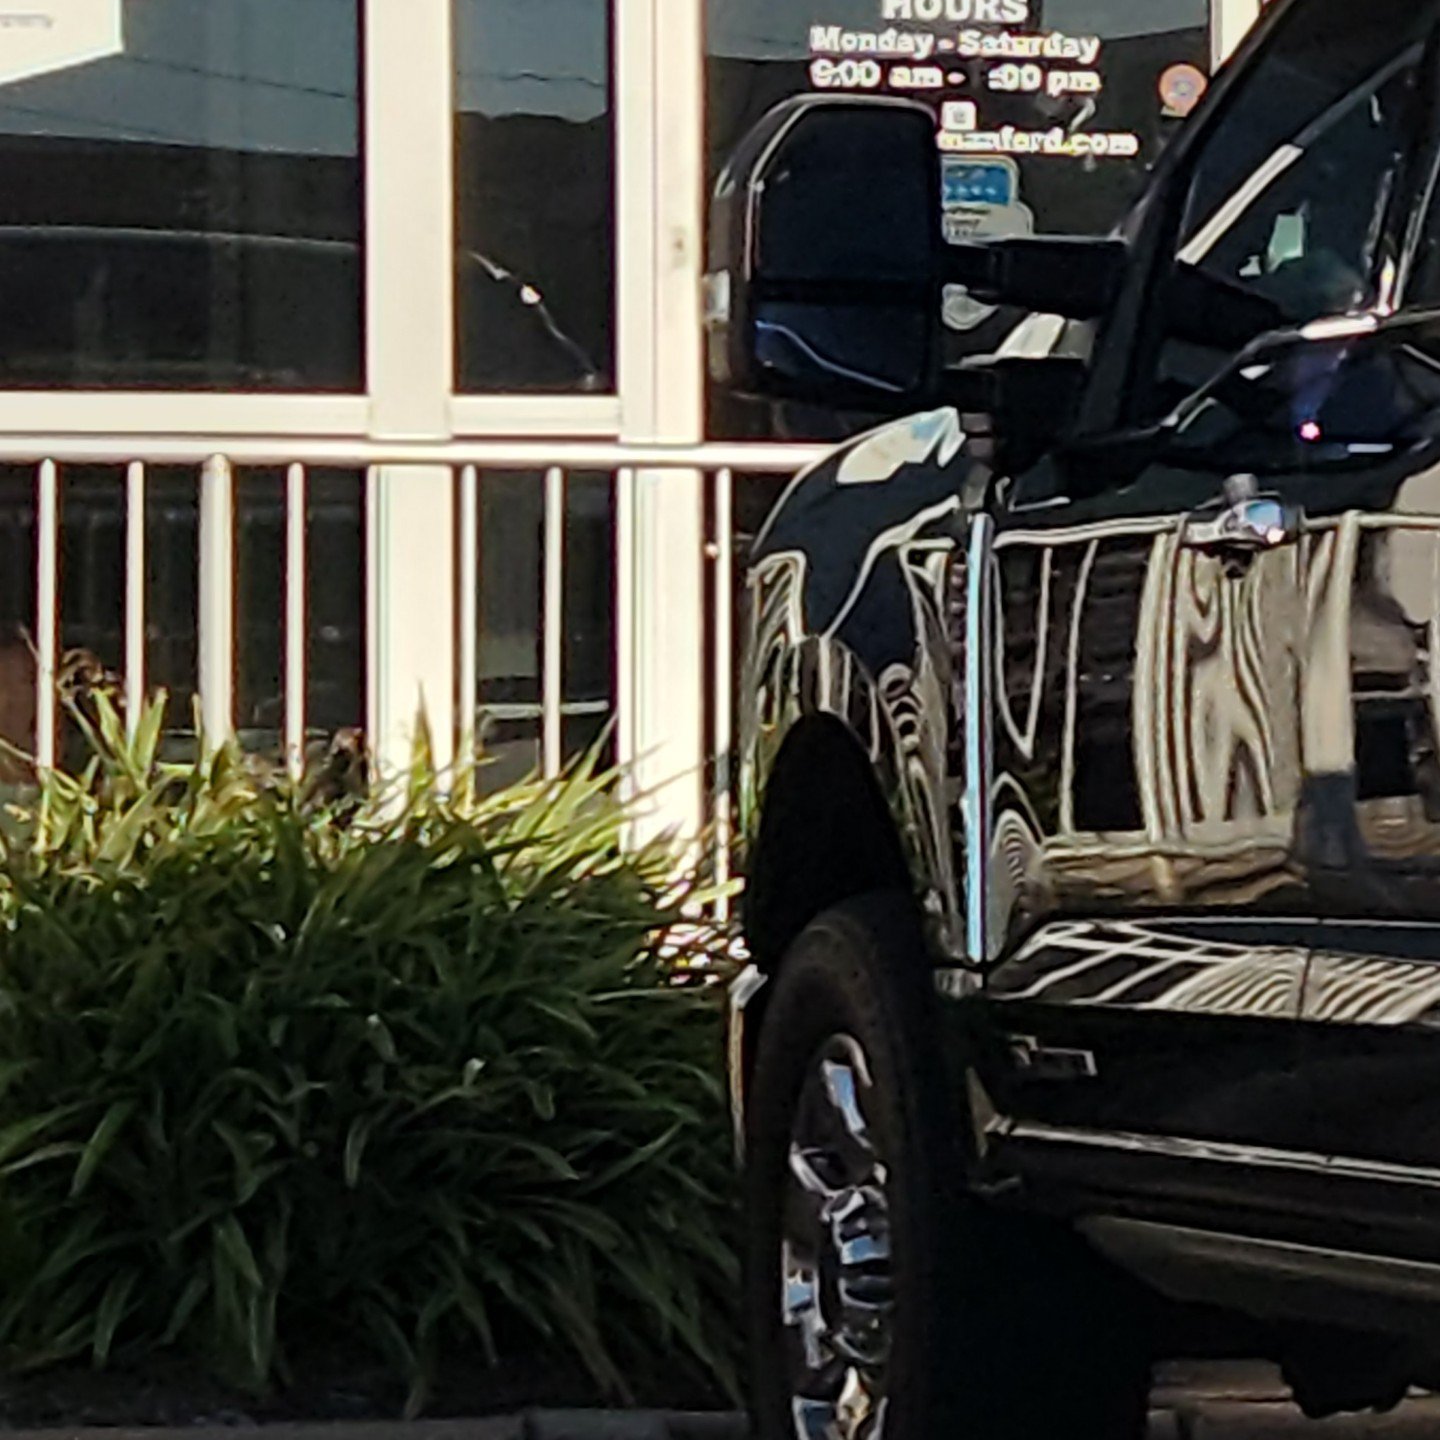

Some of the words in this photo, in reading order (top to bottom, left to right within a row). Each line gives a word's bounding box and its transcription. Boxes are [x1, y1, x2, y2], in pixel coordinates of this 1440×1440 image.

[809, 25, 935, 60] Monday
[958, 30, 1100, 64] Saturday
[889, 65, 944, 88] am
[1048, 69, 1101, 96] pm
